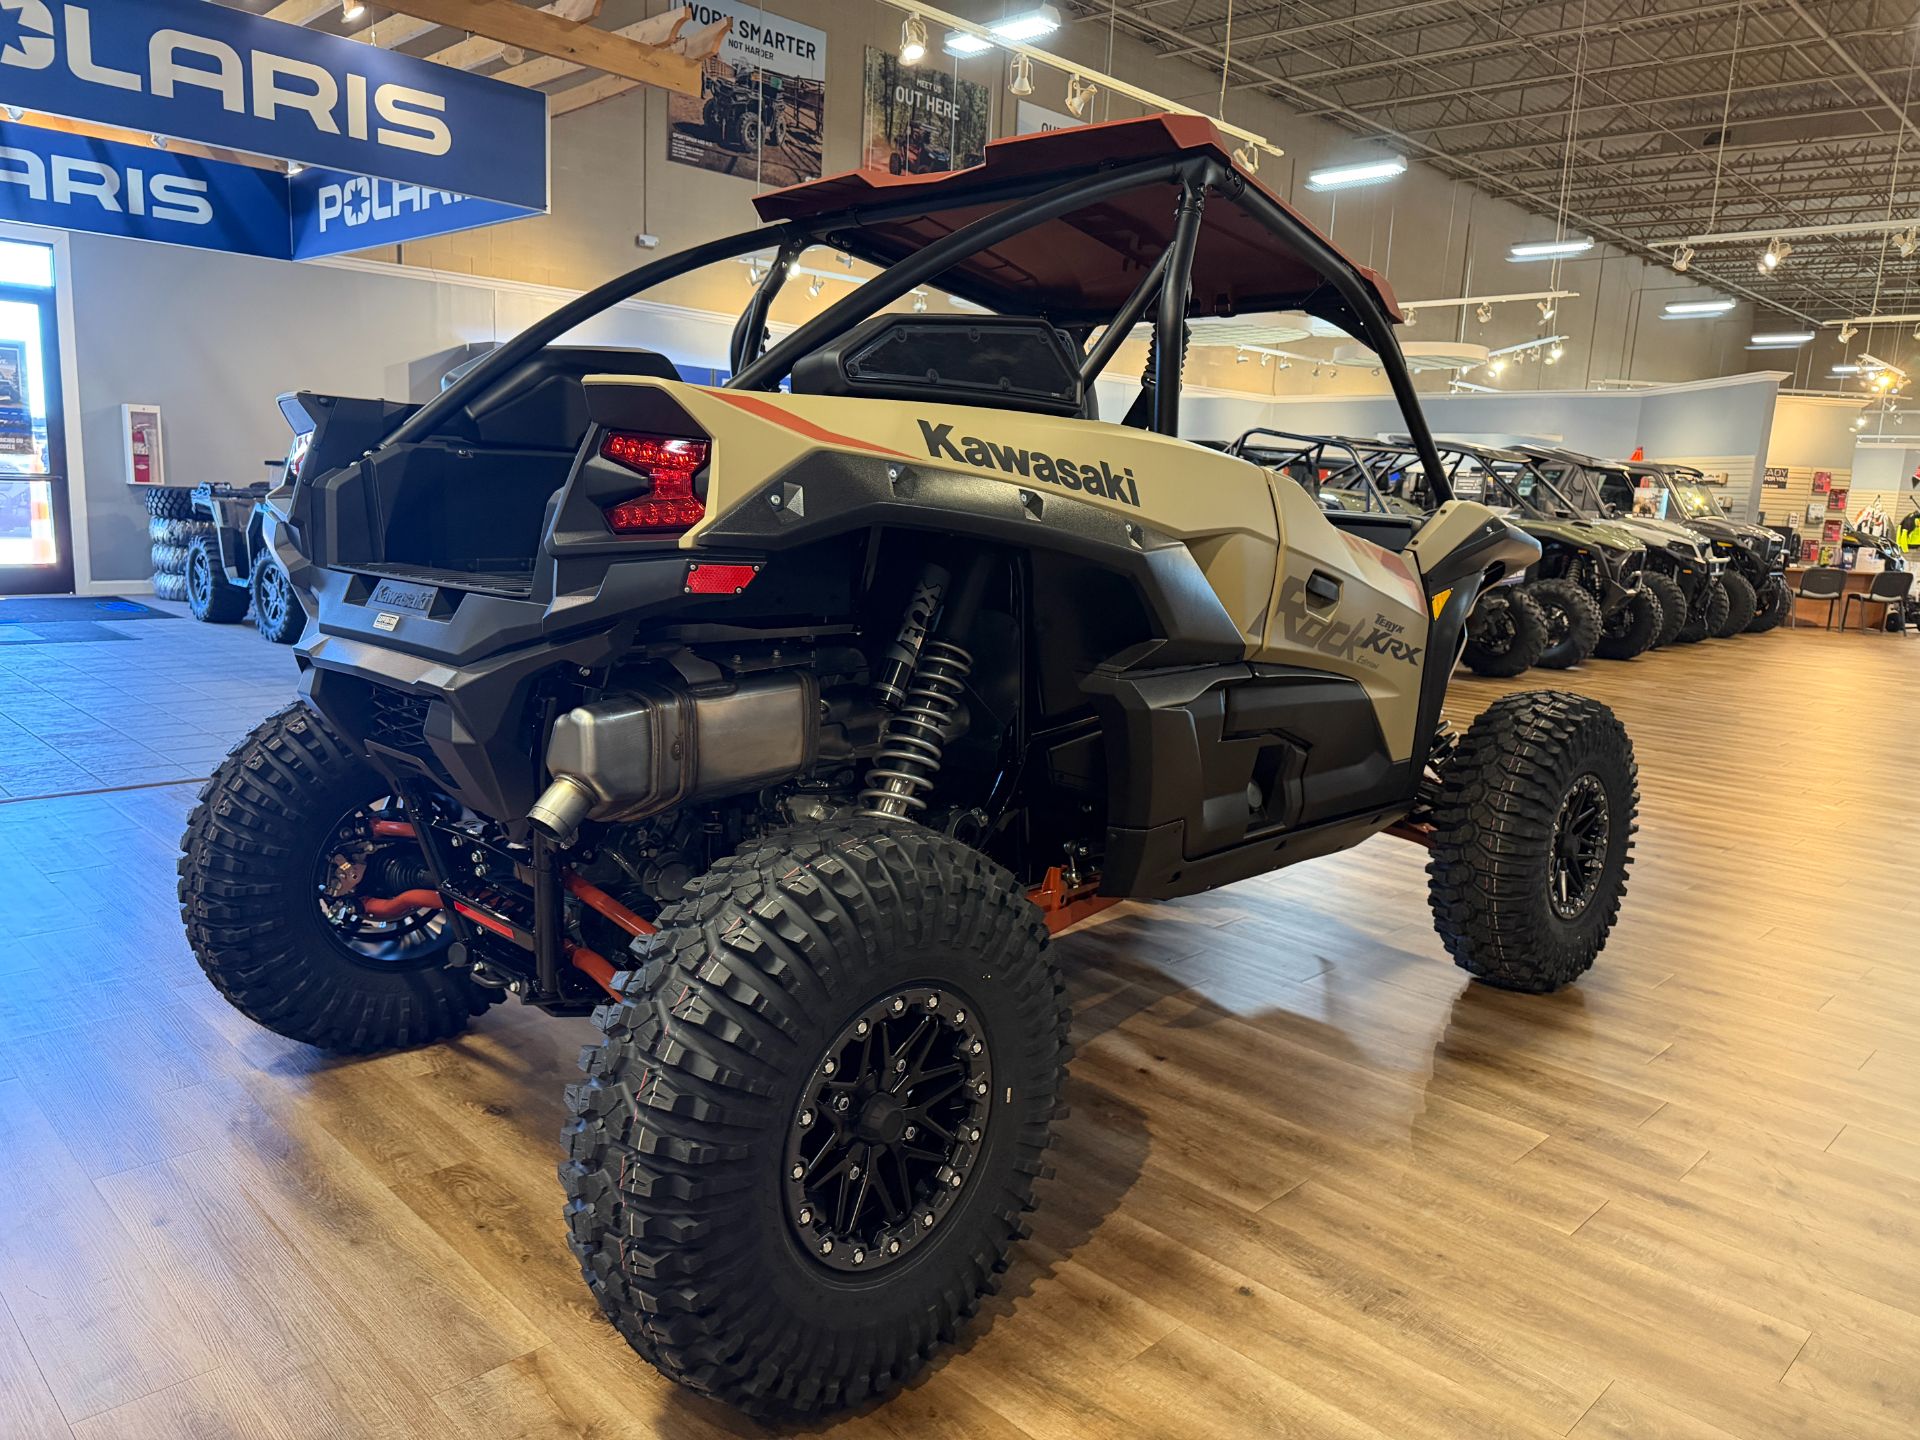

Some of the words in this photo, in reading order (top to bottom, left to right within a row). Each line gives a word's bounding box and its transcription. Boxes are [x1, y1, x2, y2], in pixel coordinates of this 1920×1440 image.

[728, 38, 743, 51] NOT
[745, 45, 774, 61] HARDER
[739, 20, 816, 60] SMARTER
[896, 86, 923, 108] OUT
[926, 95, 960, 121] HERE
[917, 79, 932, 91] MEET
[934, 84, 942, 94] US
[319, 176, 472, 232] POLA
[916, 419, 1141, 508] Kawasaki
[374, 585, 433, 610] Kawasaki
[897, 582, 941, 651] FOX
[1360, 627, 1423, 666] KRX
